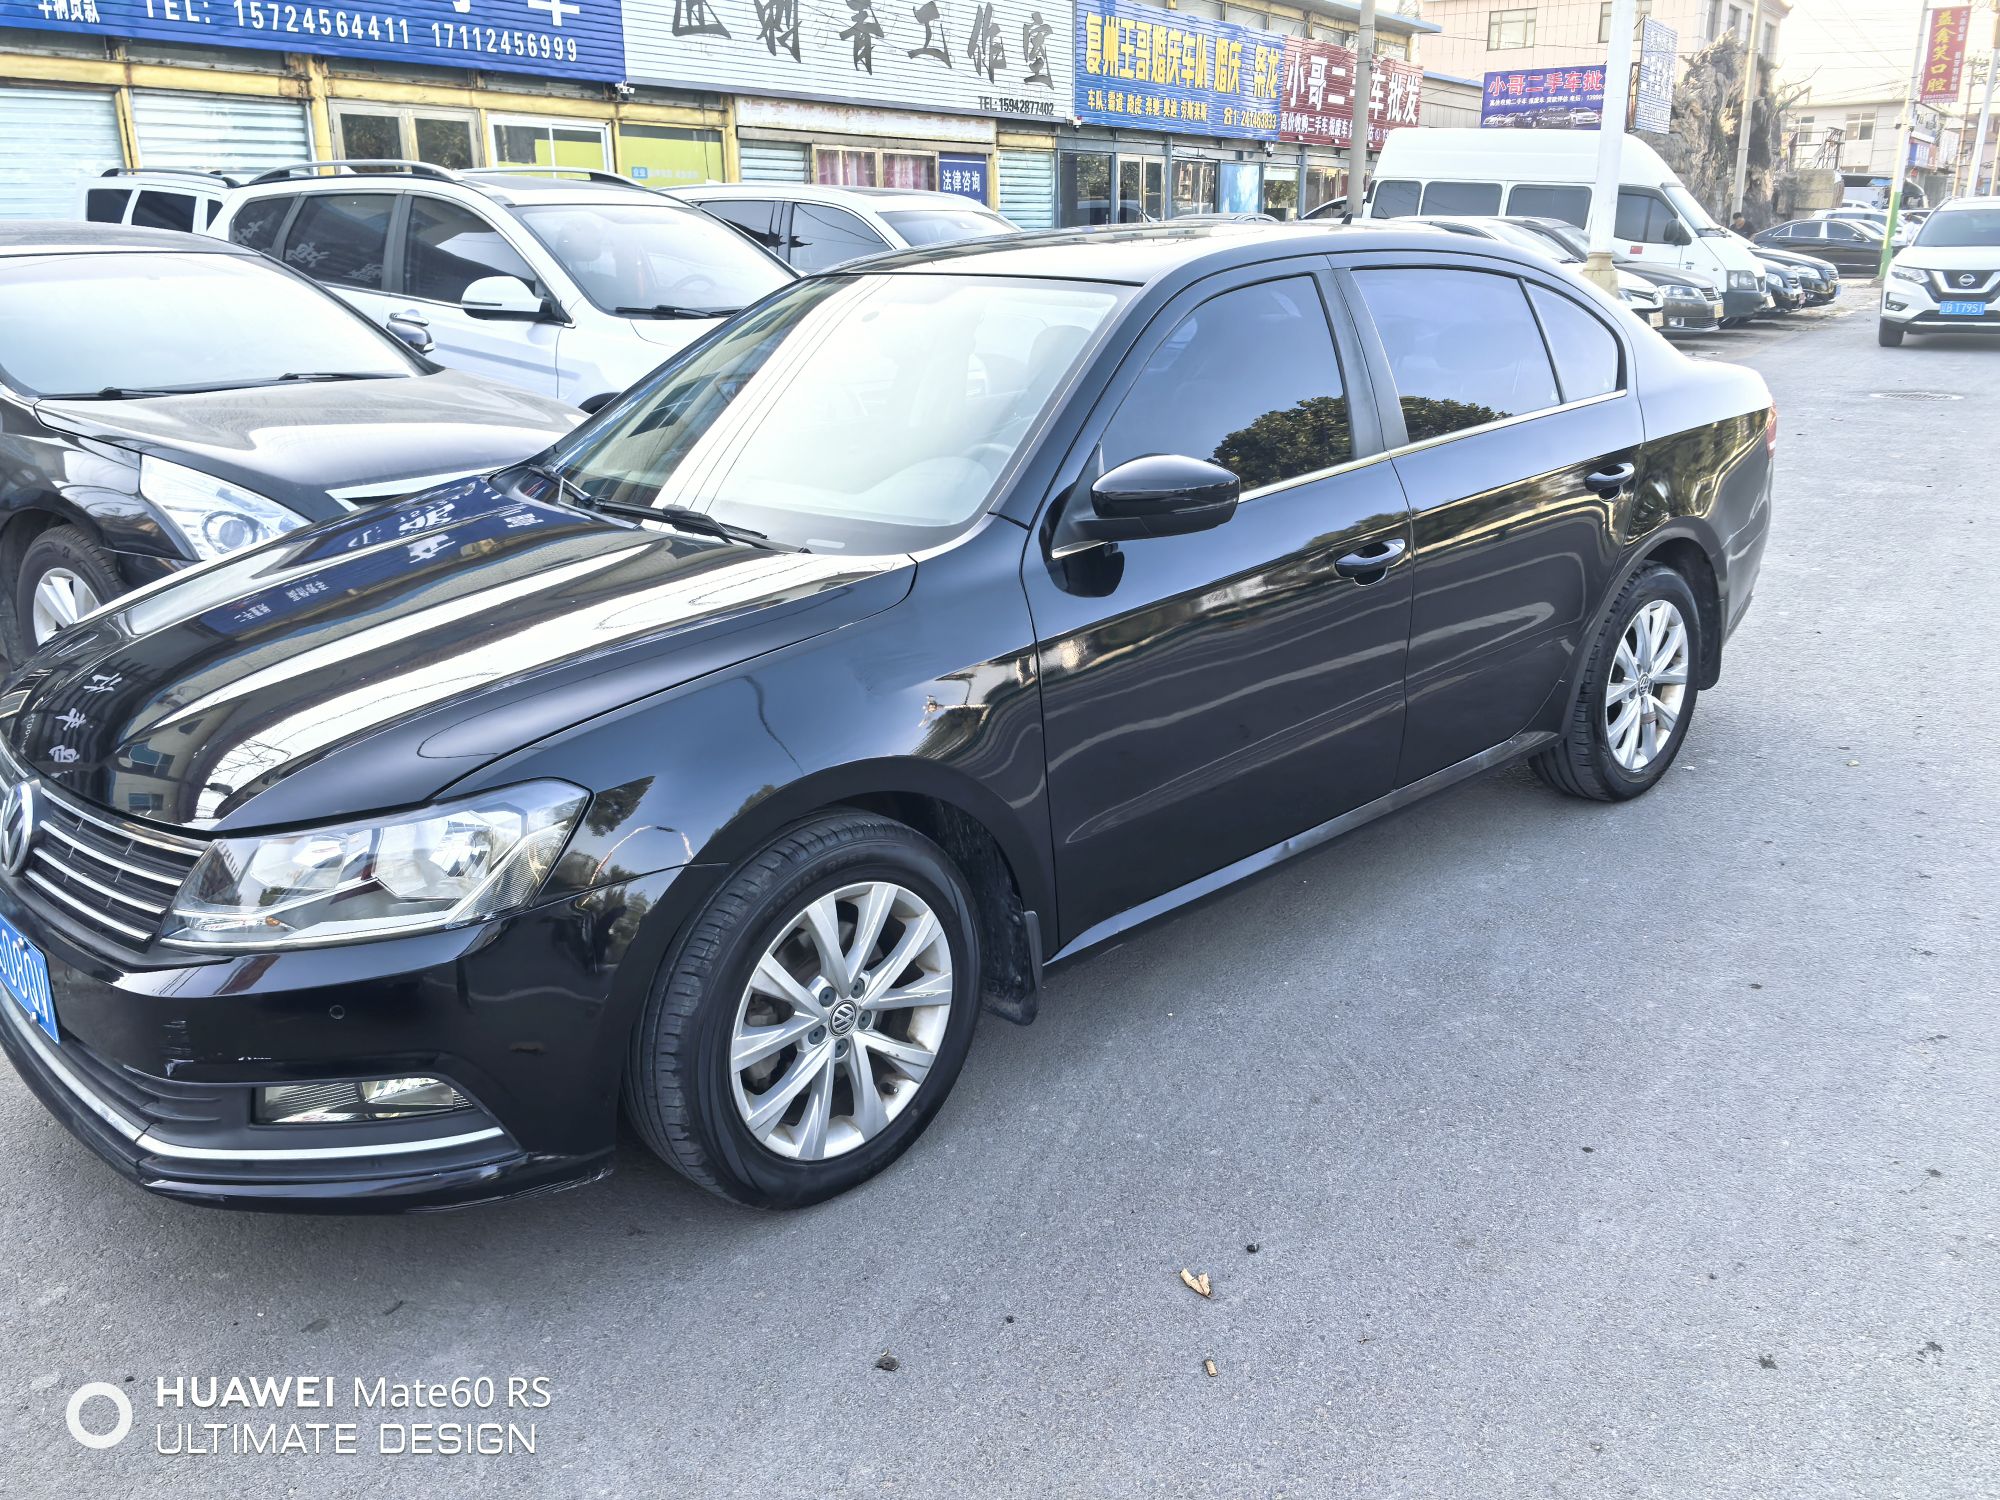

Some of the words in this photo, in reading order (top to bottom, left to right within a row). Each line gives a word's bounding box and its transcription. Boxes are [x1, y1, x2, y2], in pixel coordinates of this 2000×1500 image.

[233, 0, 409, 44] 15724564411
[431, 22, 577, 62] 17112456999
[1286, 52, 1420, 125] 小哥二车批发
[1488, 69, 1605, 97] 小哥二手车批
[942, 169, 980, 192] 法律咨询
